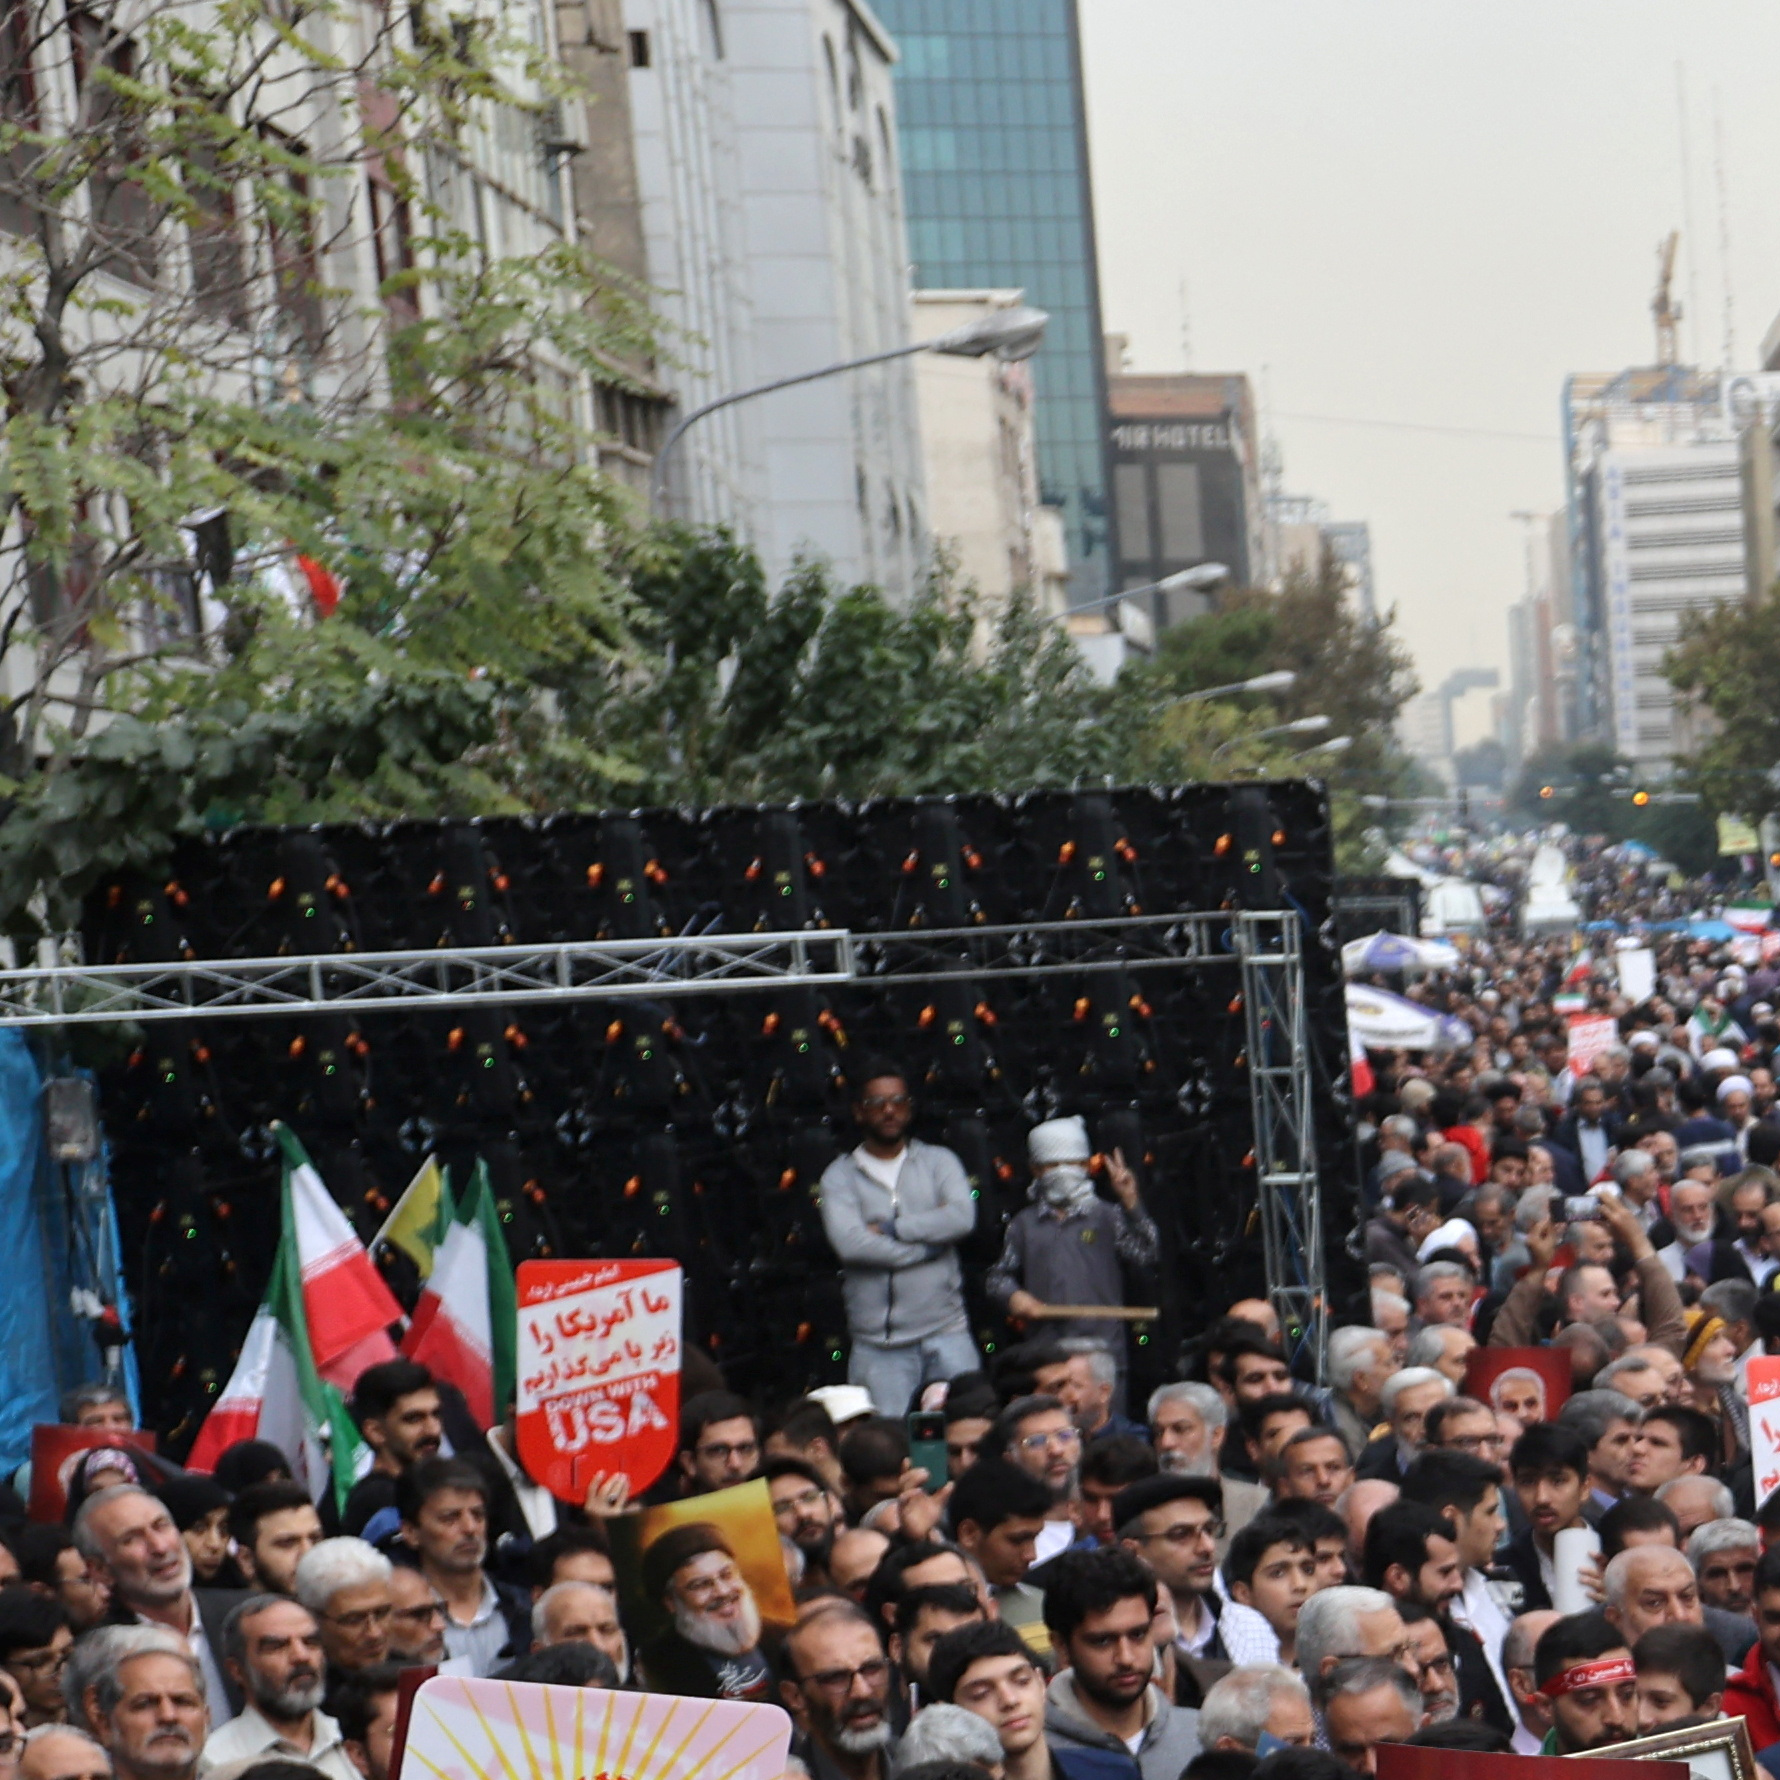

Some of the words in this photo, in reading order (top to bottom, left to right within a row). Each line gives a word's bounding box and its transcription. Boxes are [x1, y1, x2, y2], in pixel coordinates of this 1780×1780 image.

[556, 1288, 633, 1340] آمریکا
[641, 1288, 669, 1313] ما
[529, 1320, 554, 1354] را
[651, 1330, 676, 1359] زیر
[545, 1389, 604, 1412] DOWN
[607, 1375, 658, 1399] WITH
[546, 1391, 669, 1451] USA
